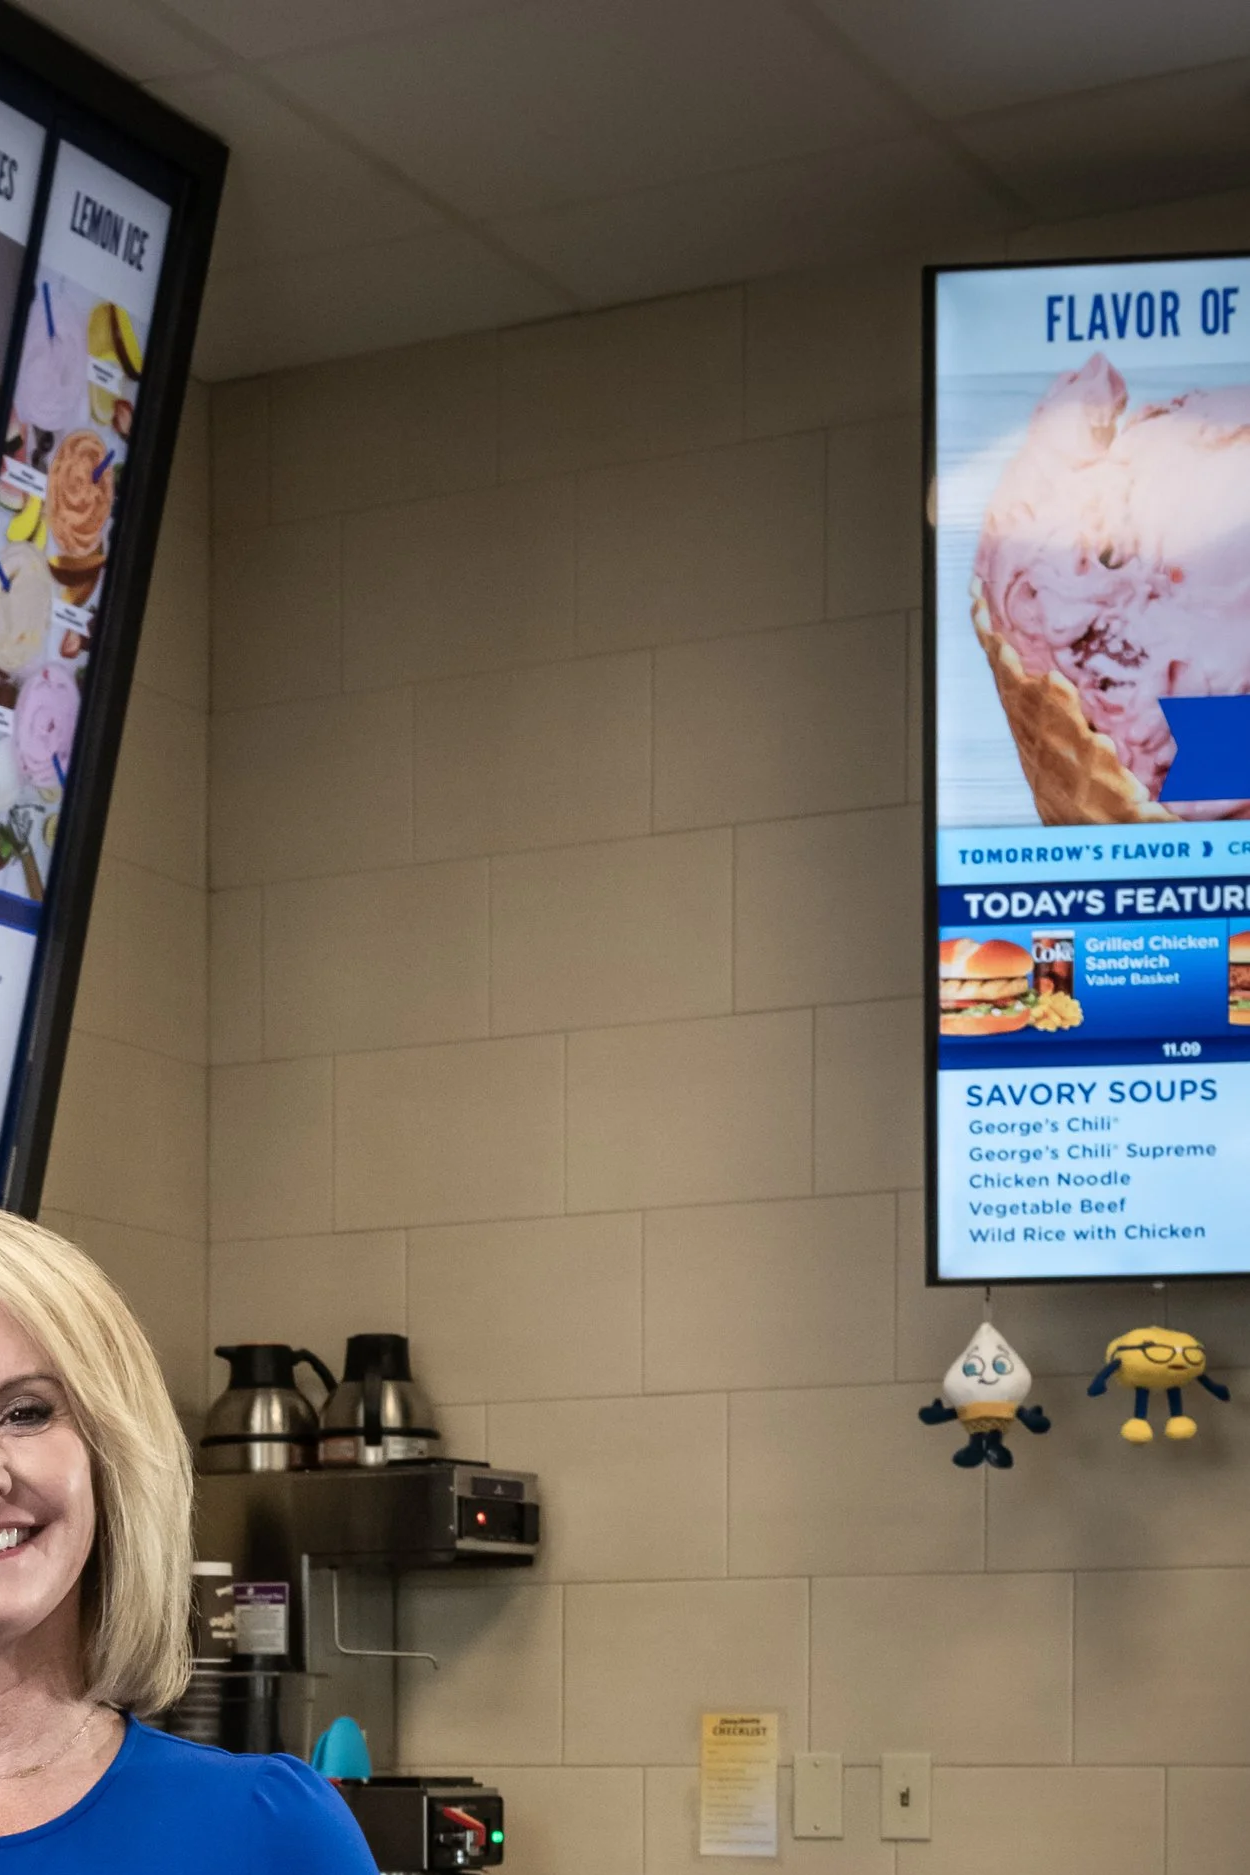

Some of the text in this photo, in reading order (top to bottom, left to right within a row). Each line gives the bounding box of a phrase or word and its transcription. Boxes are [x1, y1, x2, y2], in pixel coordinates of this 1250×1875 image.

[71, 191, 150, 273] LEMON ICE
[1047, 288, 1239, 342] FLAVOR OF
[960, 845, 1103, 865] TOMORROW'S
[1112, 842, 1190, 859] FLAVOR
[964, 889, 1105, 919] TODAY'S
[1086, 934, 1219, 953] Grilled Chicken
[1086, 955, 1169, 970] Sandwich
[1086, 971, 1180, 986] Value Basket
[1163, 1042, 1201, 1057] 11.09
[967, 1079, 1218, 1107] SAVORY SOUPS
[969, 1118, 1059, 1137] George's
[969, 1146, 1059, 1163] George's
[1126, 1142, 1217, 1160] Supreme
[969, 1171, 1131, 1188] Chicken Noodle
[969, 1198, 1126, 1218] Vegetable Beef
[969, 1224, 1205, 1243] Wild Rice with Chicken
